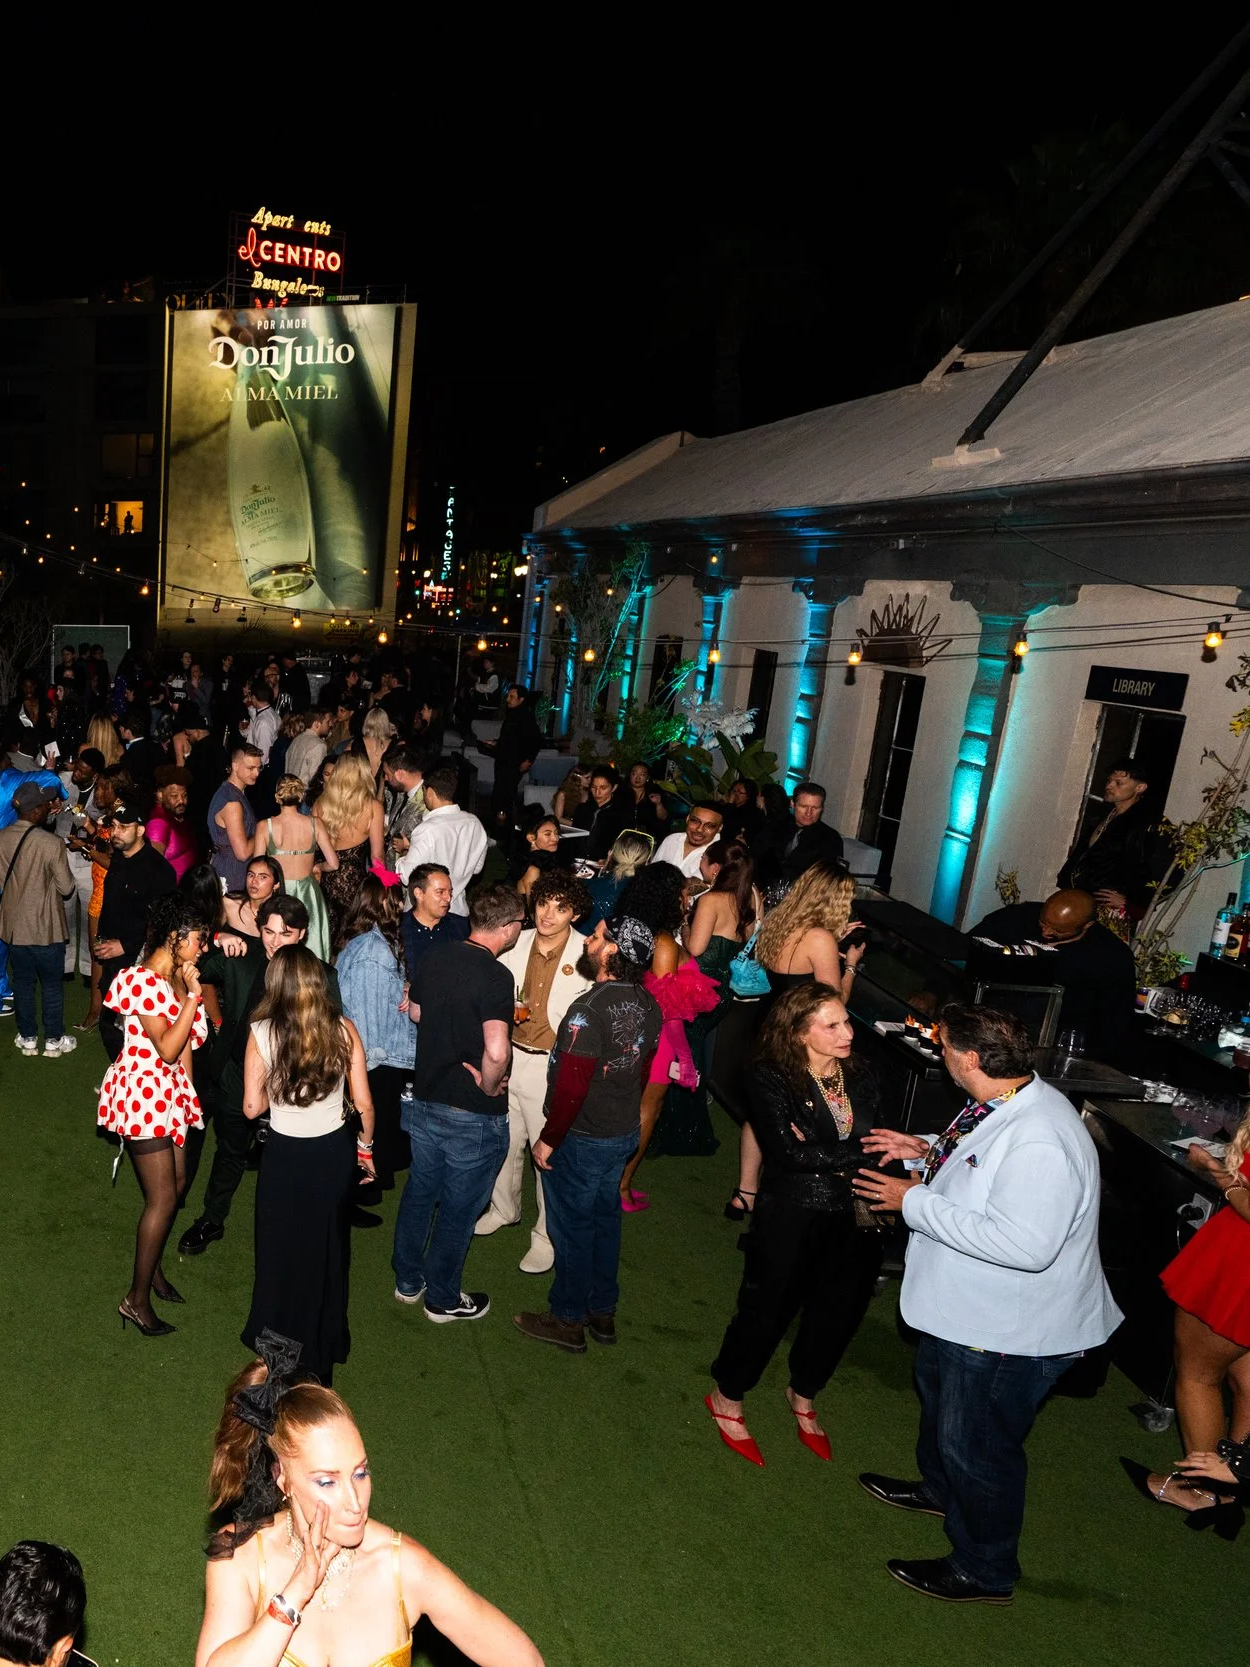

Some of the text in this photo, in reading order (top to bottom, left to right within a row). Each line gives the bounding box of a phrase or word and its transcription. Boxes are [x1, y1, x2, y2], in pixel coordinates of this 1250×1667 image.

[251, 206, 332, 236] Apartents
[260, 240, 342, 271] CENTRO
[257, 318, 307, 330] POR AMOR
[285, 385, 338, 400] MIEL
[1112, 678, 1156, 697] LIBRARY
